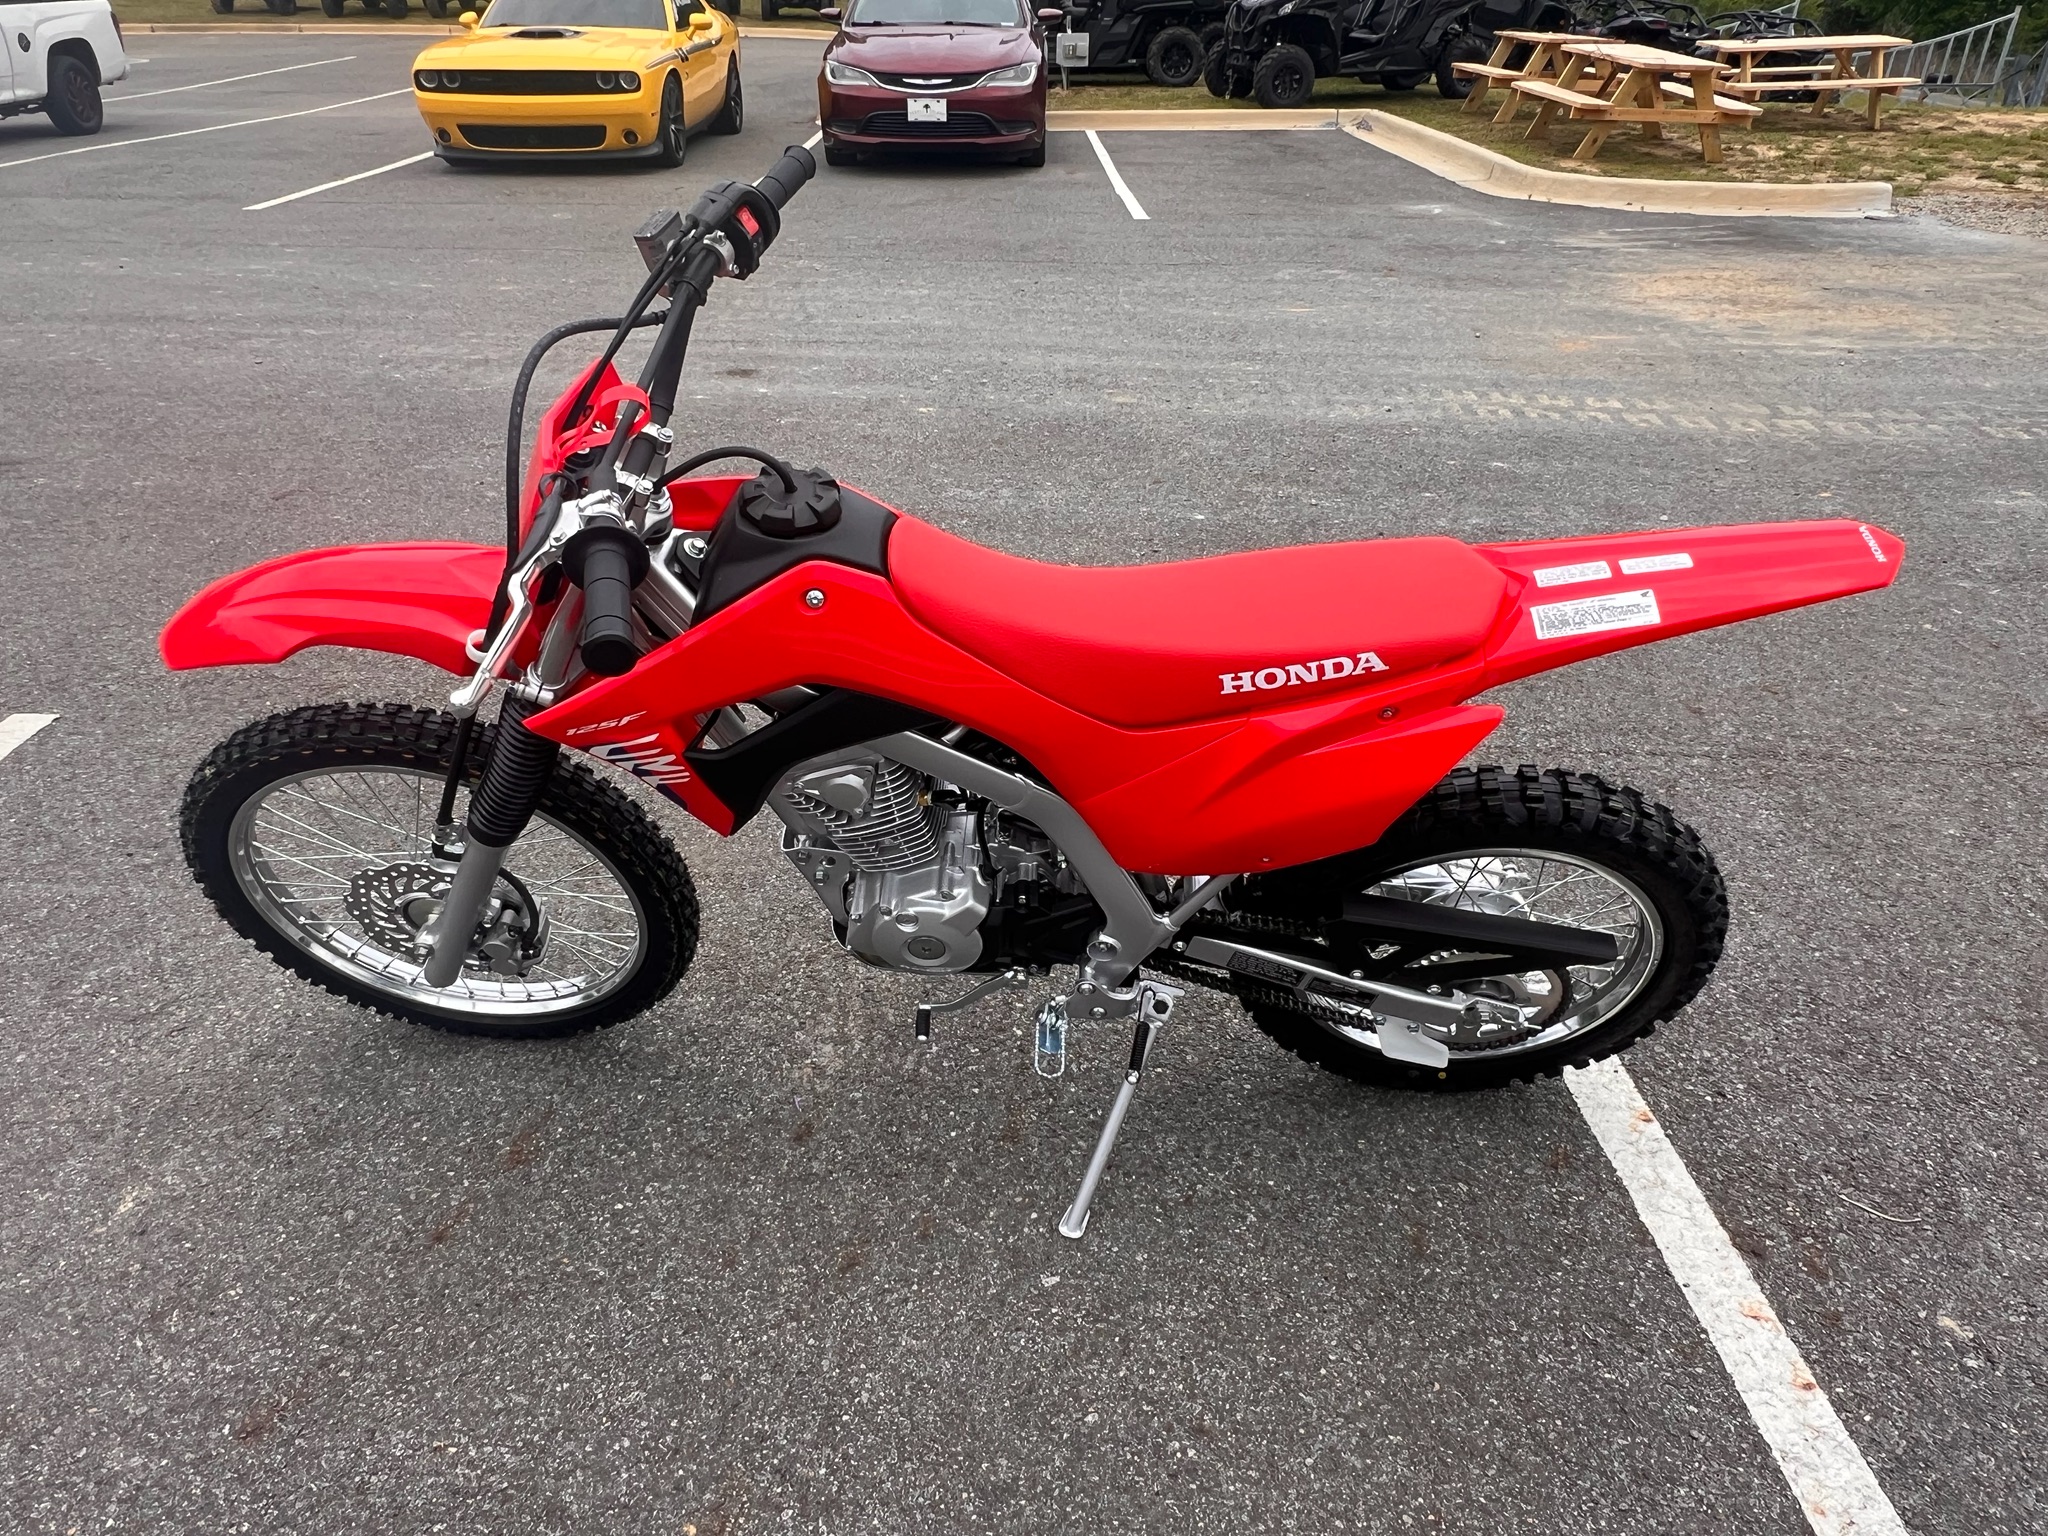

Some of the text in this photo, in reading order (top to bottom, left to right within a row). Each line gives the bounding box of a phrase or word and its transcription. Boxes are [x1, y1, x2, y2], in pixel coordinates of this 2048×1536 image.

[1859, 525, 1887, 562] HONDA
[1219, 651, 1390, 695] HONDA
[566, 711, 647, 735] 125F
